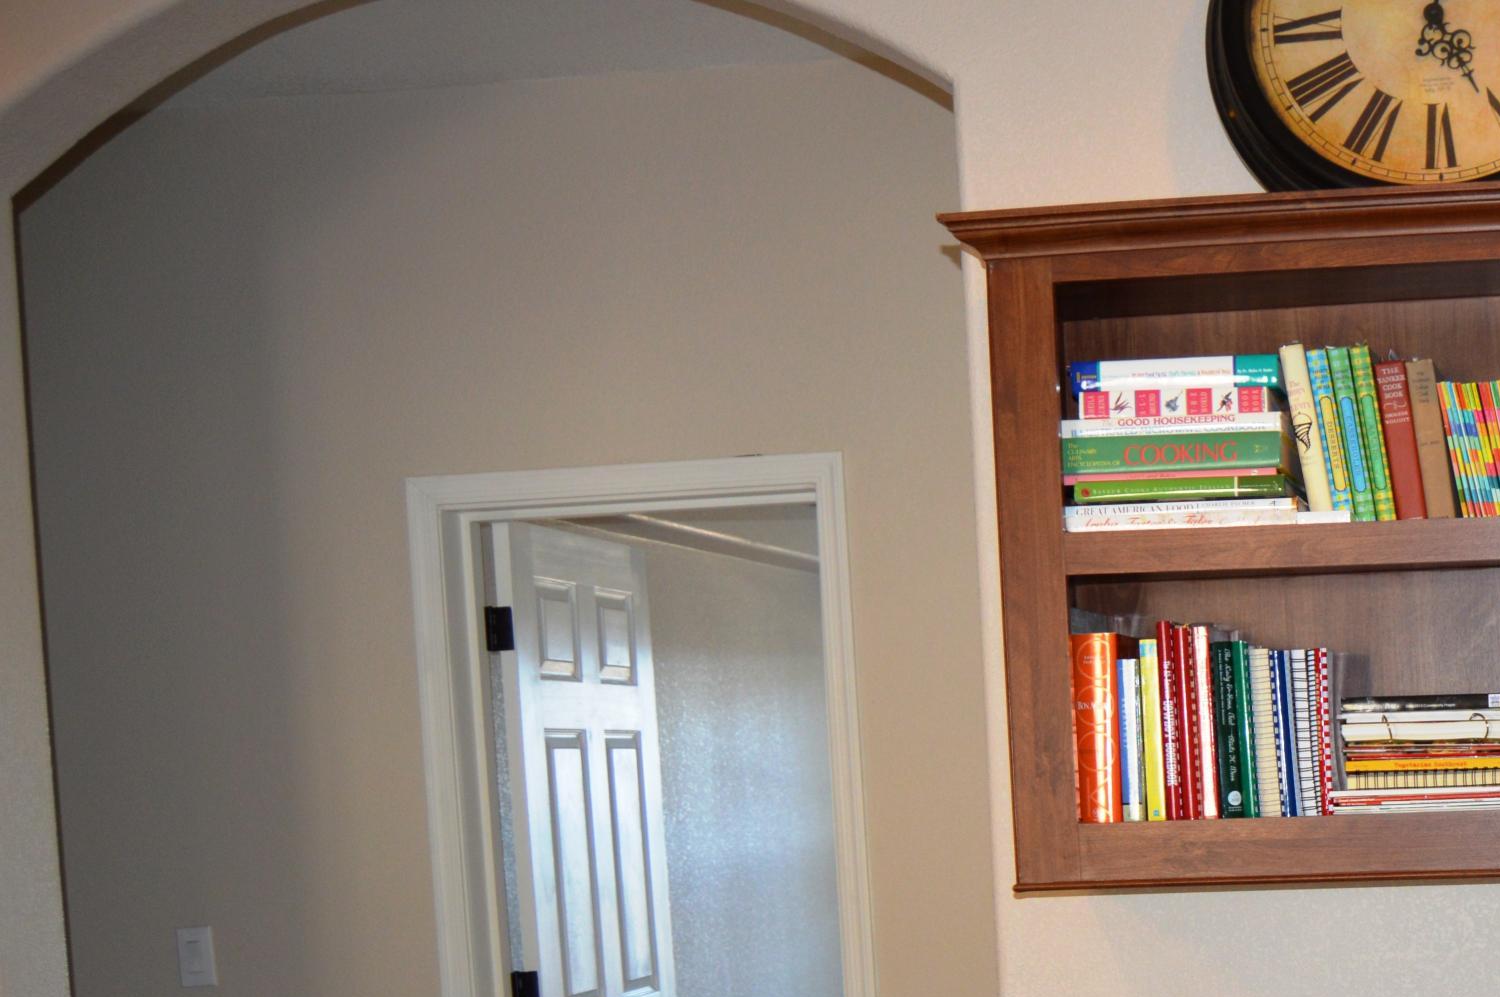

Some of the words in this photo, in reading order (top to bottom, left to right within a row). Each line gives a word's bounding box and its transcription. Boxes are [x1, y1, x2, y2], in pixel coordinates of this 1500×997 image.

[1421, 102, 1461, 170] VI
[1383, 383, 1403, 391] COOK
[1384, 391, 1404, 399] BOOK
[1117, 417, 1151, 427] GOOD
[1153, 414, 1236, 425] HOUSEKEEPING
[1123, 440, 1238, 466] COOKING
[1075, 507, 1108, 516] GREAT
[1112, 504, 1161, 515] AMERICAN
[1165, 742, 1178, 787] COOKBOOK
